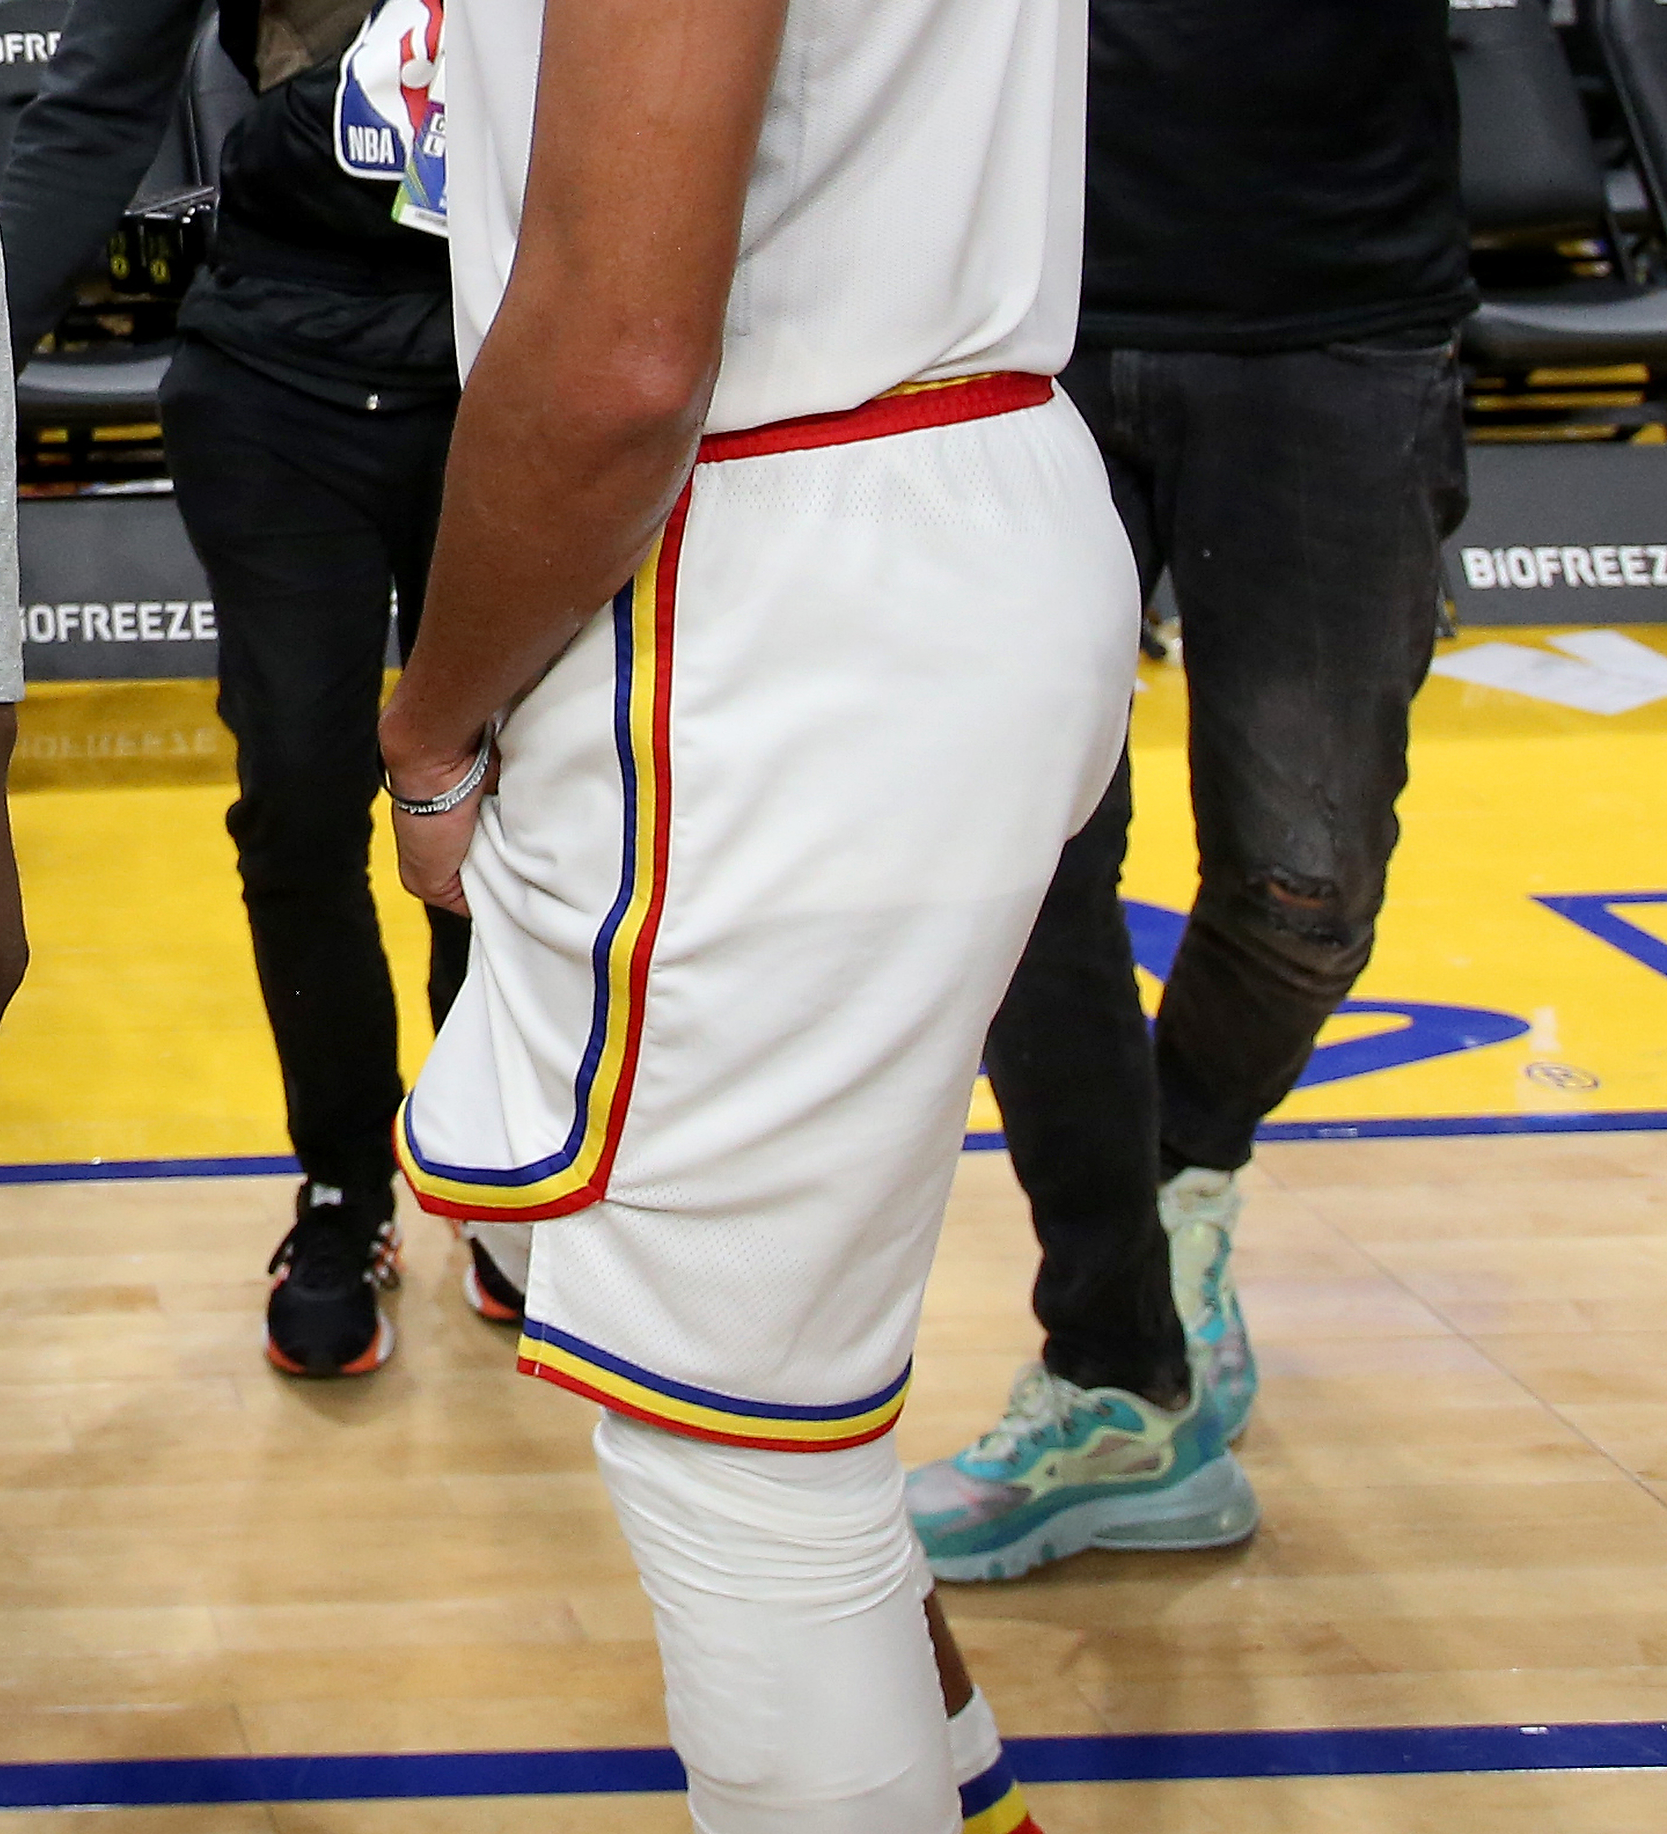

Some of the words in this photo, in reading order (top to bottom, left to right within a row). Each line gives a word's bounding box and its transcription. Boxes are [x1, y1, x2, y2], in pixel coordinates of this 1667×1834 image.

[348, 125, 395, 164] NBA
[1460, 544, 1667, 589] BIOFREEZ
[18, 600, 217, 643] IOFREEZE
